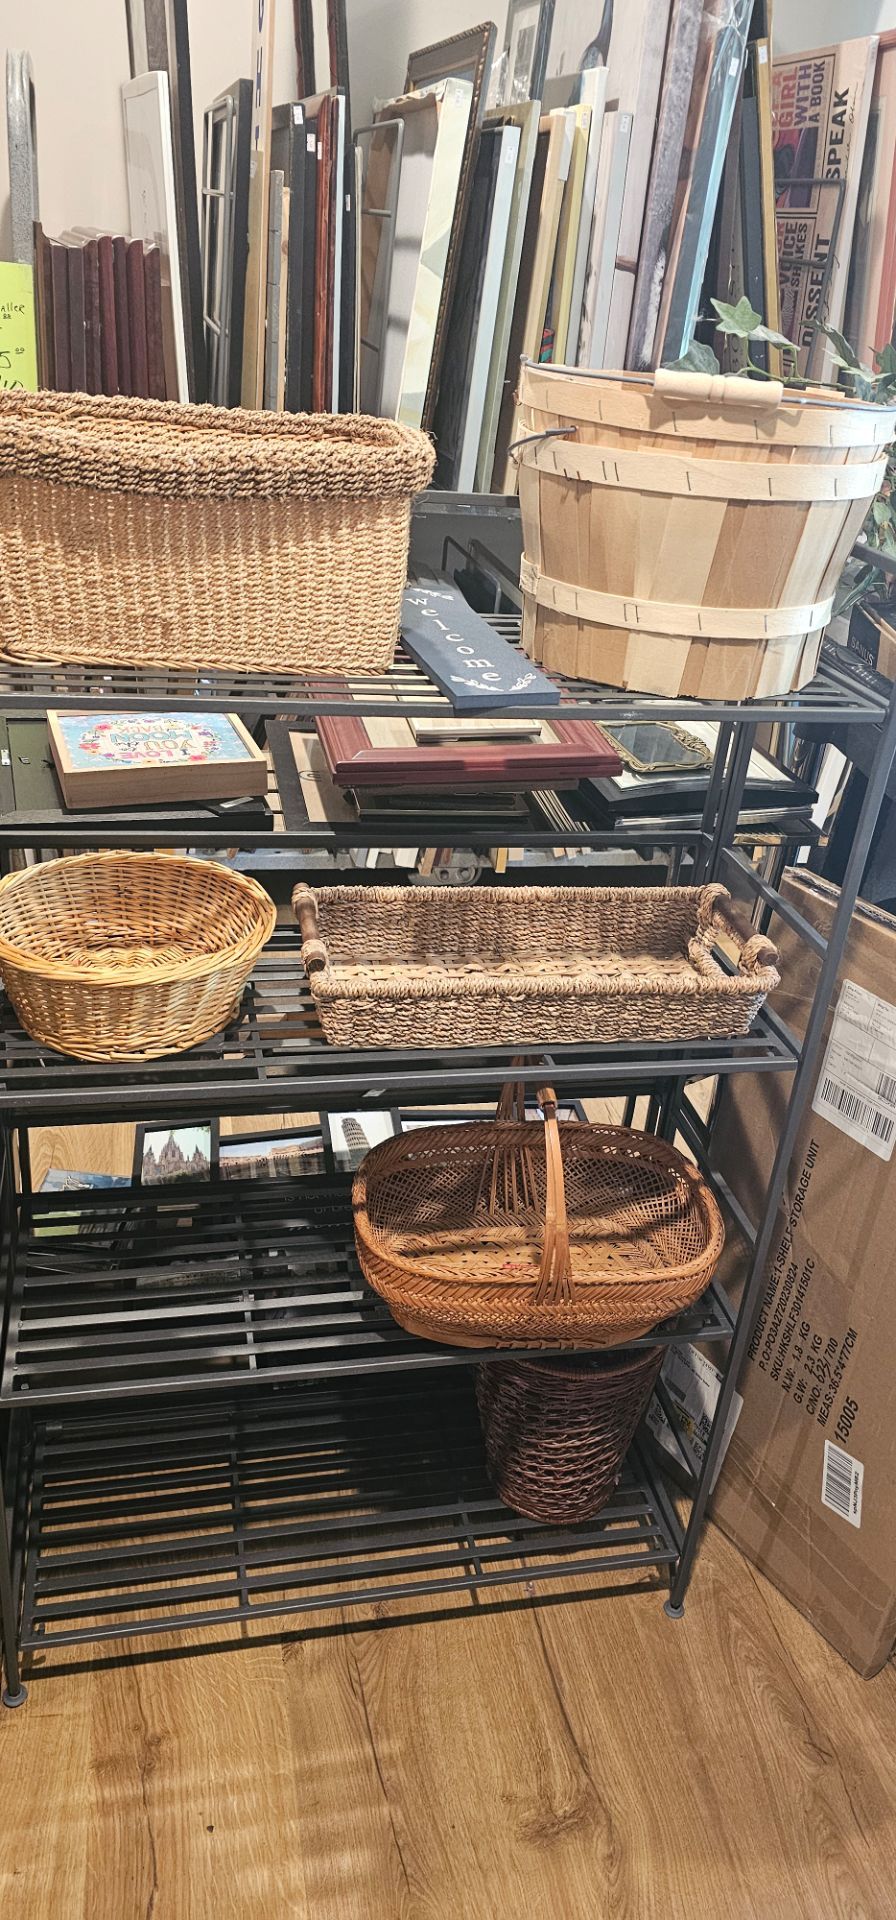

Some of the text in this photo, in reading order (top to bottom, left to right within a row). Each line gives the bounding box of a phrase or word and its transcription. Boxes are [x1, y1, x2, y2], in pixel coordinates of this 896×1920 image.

[778, 66, 798, 128] GIRL
[793, 62, 812, 127] WITH
[808, 59, 826, 123] A BOOK
[826, 87, 850, 179] SPEAK
[801, 234, 830, 348] DSSENT
[405, 598, 502, 681] welcome
[851, 636, 874, 666] SANUS
[110, 730, 193, 744] MOON
[119, 749, 174, 759] LOVE
[143, 739, 198, 751] YOU
[747, 1308, 769, 1361] PRODUCT
[789, 1169, 811, 1228] STORAGE
[805, 1139, 820, 1170] UNIT
[781, 1321, 811, 1393] N.W: 1.8 KG
[793, 1334, 823, 1404] G.W: 2.3 KG
[834, 1395, 859, 1444] 15005
